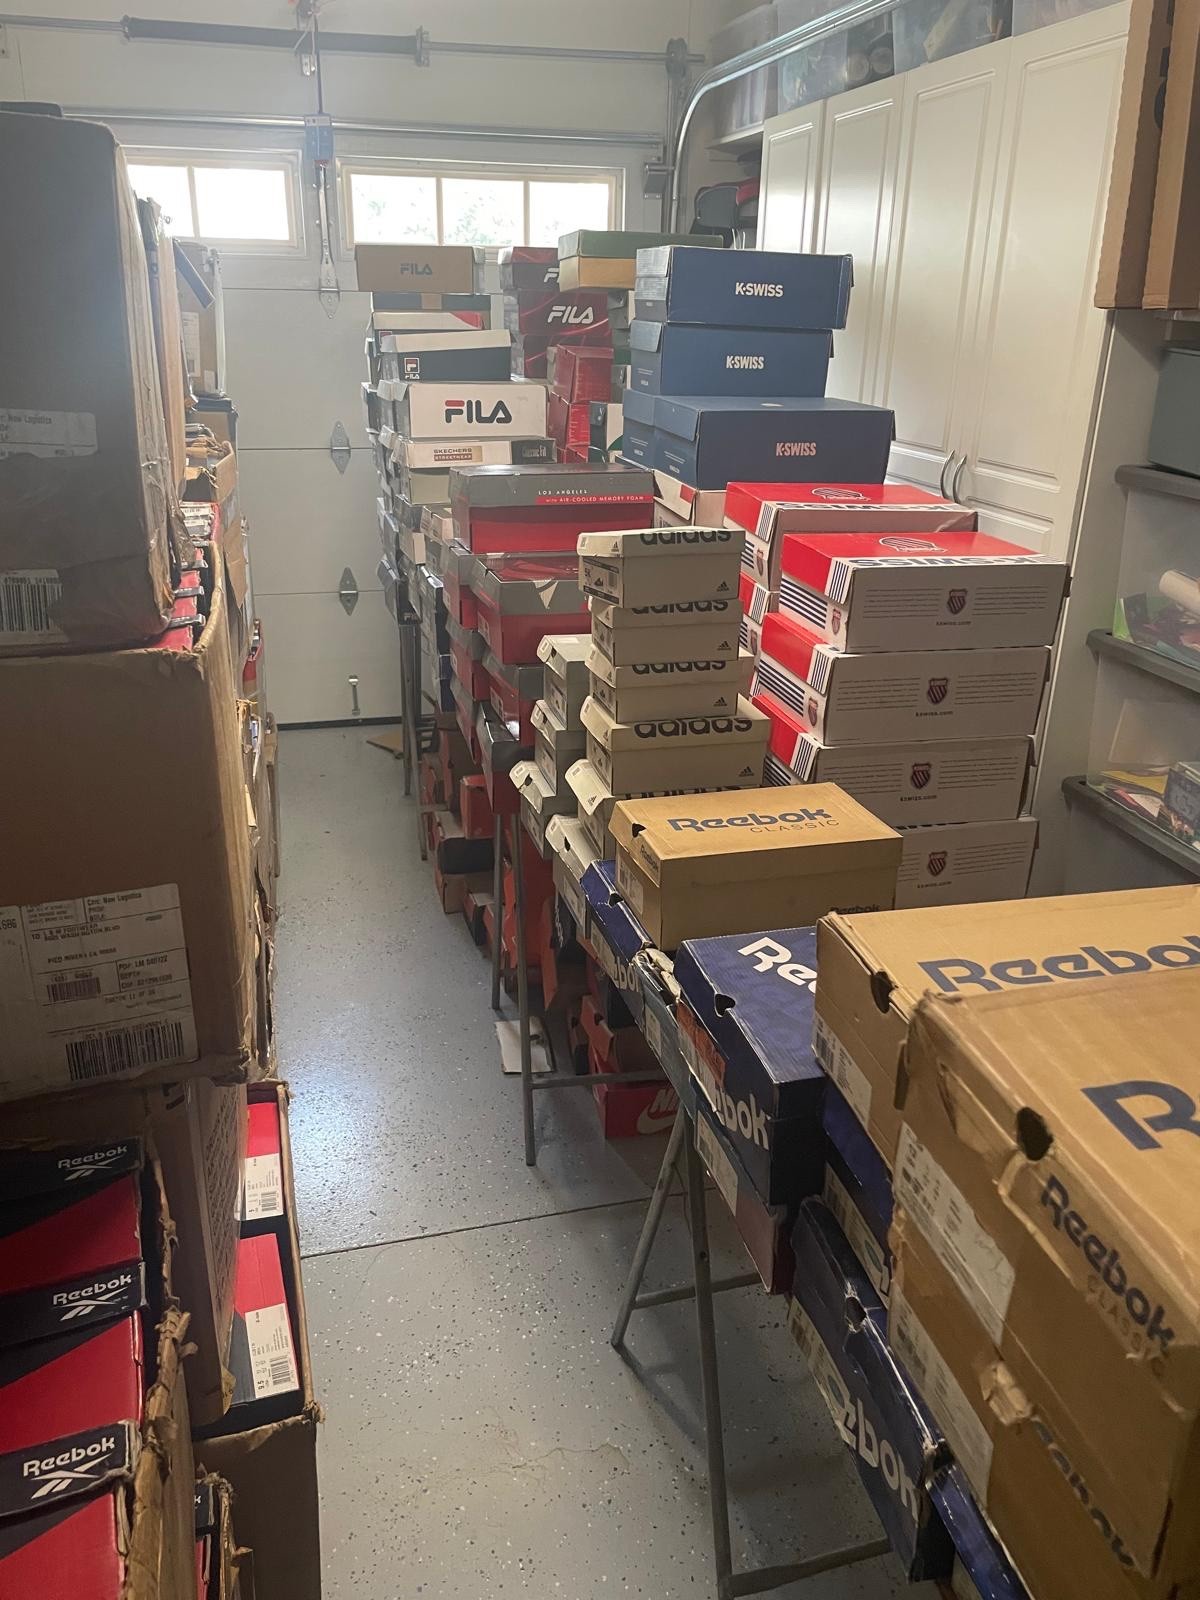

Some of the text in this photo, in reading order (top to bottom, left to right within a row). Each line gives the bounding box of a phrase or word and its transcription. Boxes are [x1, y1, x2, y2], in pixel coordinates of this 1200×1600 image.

[400, 263, 433, 276] FILA
[548, 305, 594, 324] FILA
[444, 399, 513, 424] FILA
[433, 447, 472, 455] SKECHERS
[634, 718, 753, 739] adidas
[667, 807, 834, 832] Reebok
[750, 820, 841, 834] CLASSIC
[57, 1143, 128, 1169] Reebok
[1041, 1174, 1175, 1348] Reebok
[53, 1272, 132, 1305] Reebok
[23, 1435, 116, 1477] Reebok
